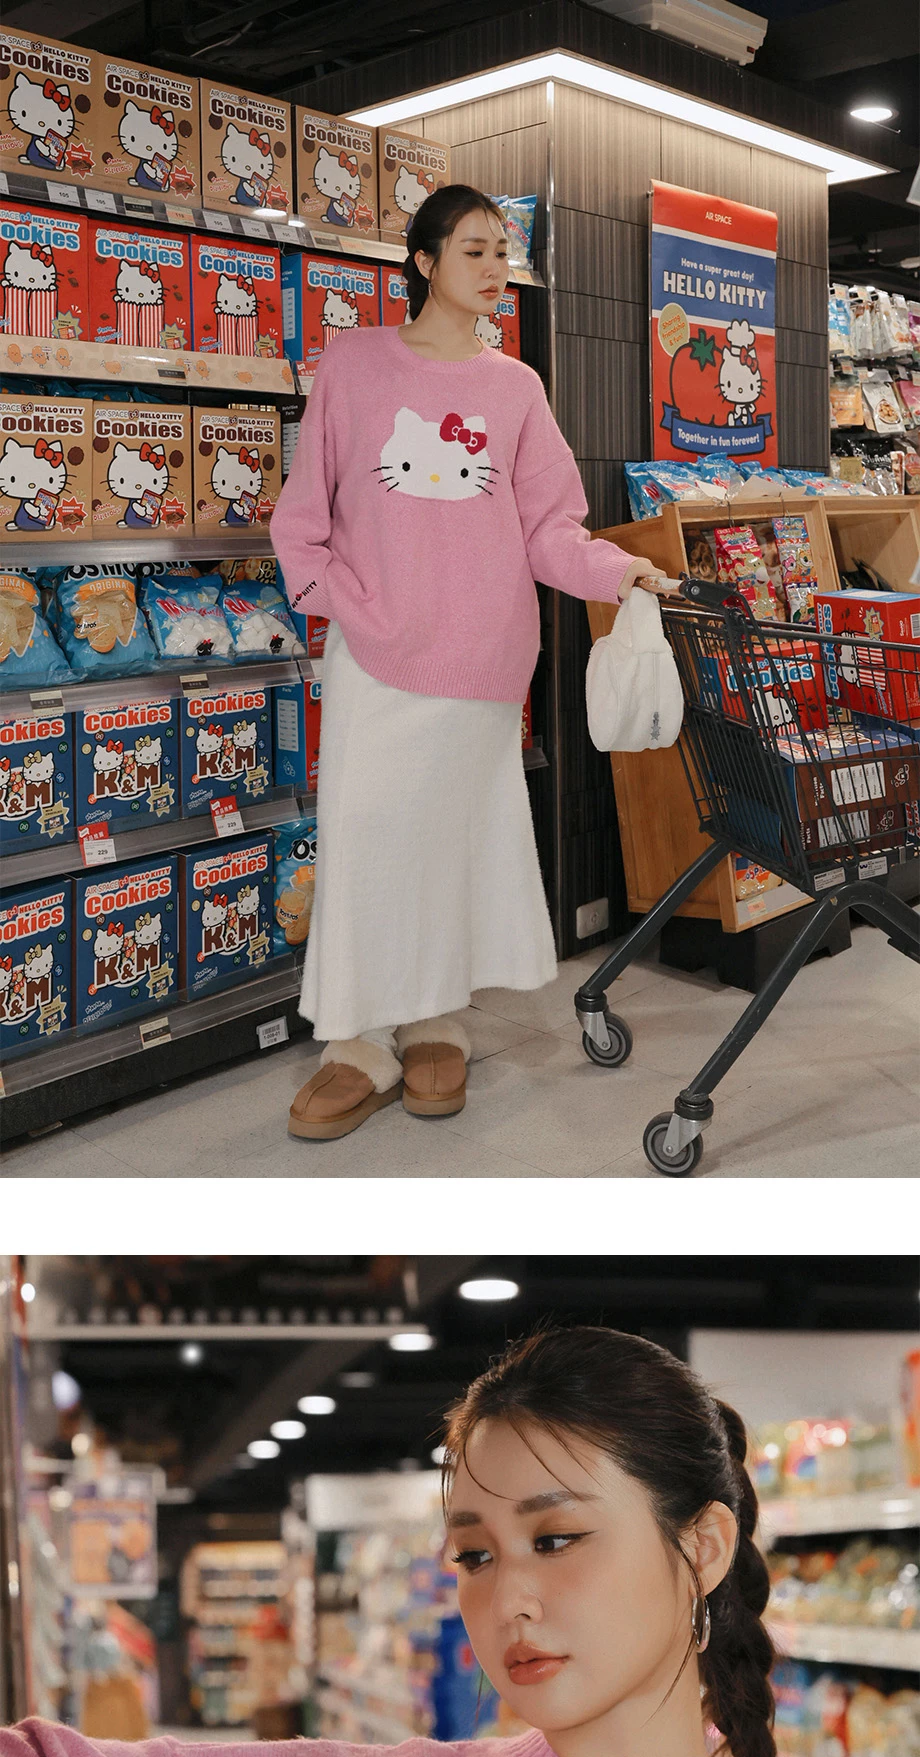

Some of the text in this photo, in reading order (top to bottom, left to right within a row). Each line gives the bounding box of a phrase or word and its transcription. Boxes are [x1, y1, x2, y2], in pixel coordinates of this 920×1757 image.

[106, 64, 191, 92] AIR SPACE HELLO KITTY
[106, 73, 191, 109] Cookies
[211, 98, 285, 132] Cookies
[705, 211, 732, 225] AIR SPACE
[96, 238, 183, 267] Cookies
[140, 234, 183, 248] HELLO KITTY
[200, 253, 275, 280] Cookies
[681, 257, 698, 270] Have
[704, 263, 722, 276] super
[723, 266, 740, 280] great
[740, 269, 754, 283] day!
[309, 270, 374, 294] Cookies
[663, 271, 766, 309] HELLO KITTY
[662, 314, 681, 331] Sharing
[662, 321, 687, 341] friendship
[96, 420, 182, 438] Cookies
[201, 425, 273, 443] Cookies
[677, 428, 759, 447] Together in fun forever!
[188, 693, 265, 717] Cookies
[85, 706, 171, 732] Cookies
[198, 749, 255, 778] K&M
[95, 764, 160, 798] K&M
[129, 866, 171, 884] HELLO KITTY
[194, 855, 267, 889] Cookies
[85, 878, 170, 916] Cookies
[203, 915, 257, 954] K&M
[95, 942, 160, 989] K&M
